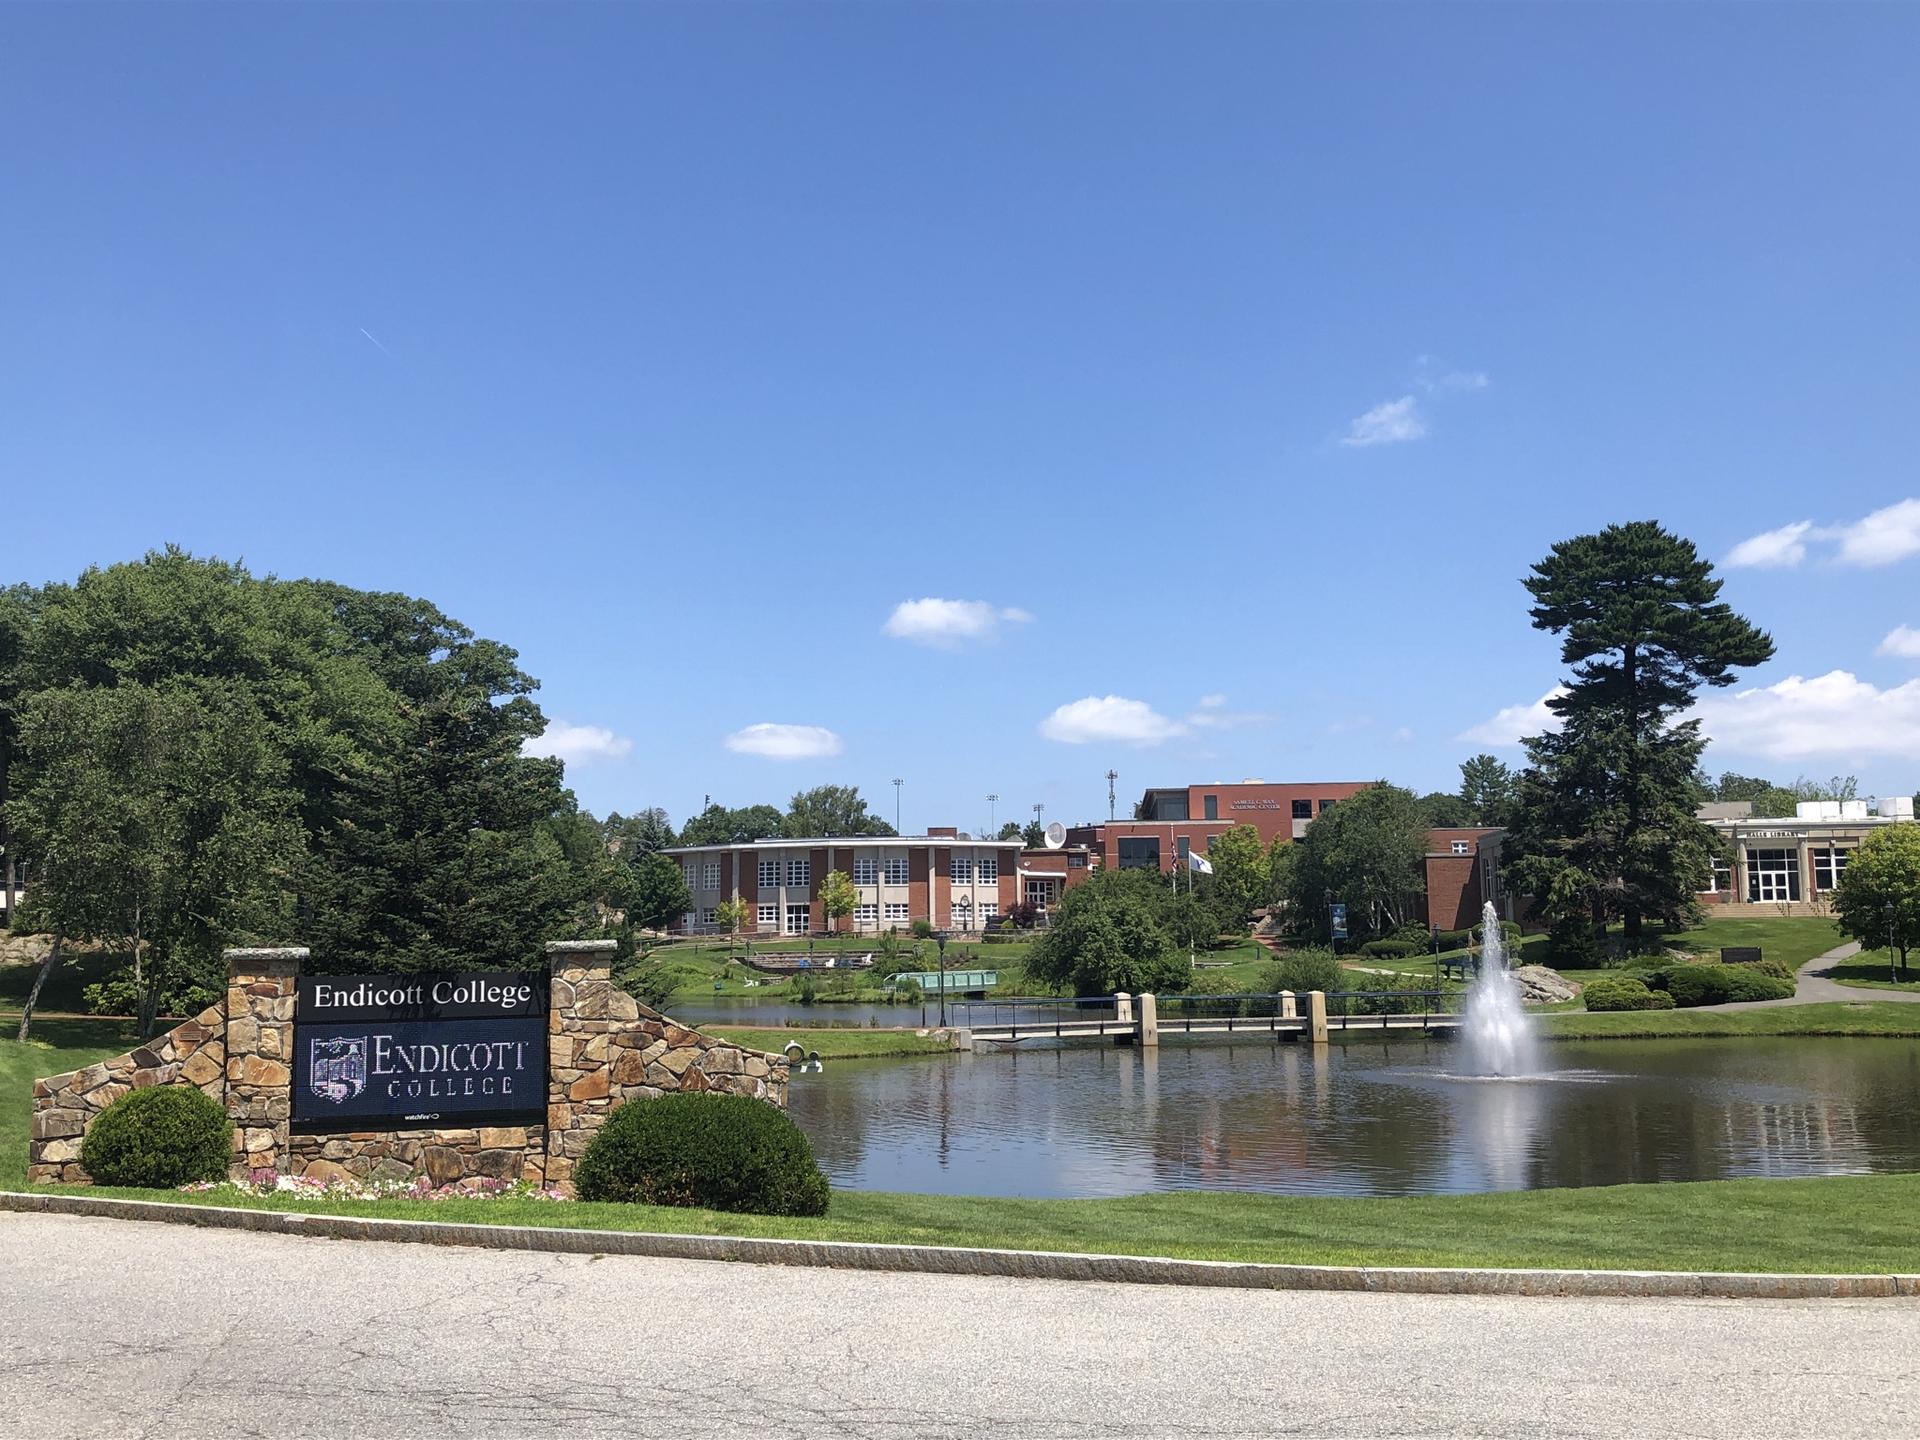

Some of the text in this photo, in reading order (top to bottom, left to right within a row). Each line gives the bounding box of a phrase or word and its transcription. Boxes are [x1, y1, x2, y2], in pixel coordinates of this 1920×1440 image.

[314, 979, 531, 1008] Endicott College
[371, 1035, 529, 1075] ENDICOTT
[388, 1076, 512, 1098] COLLEGE
